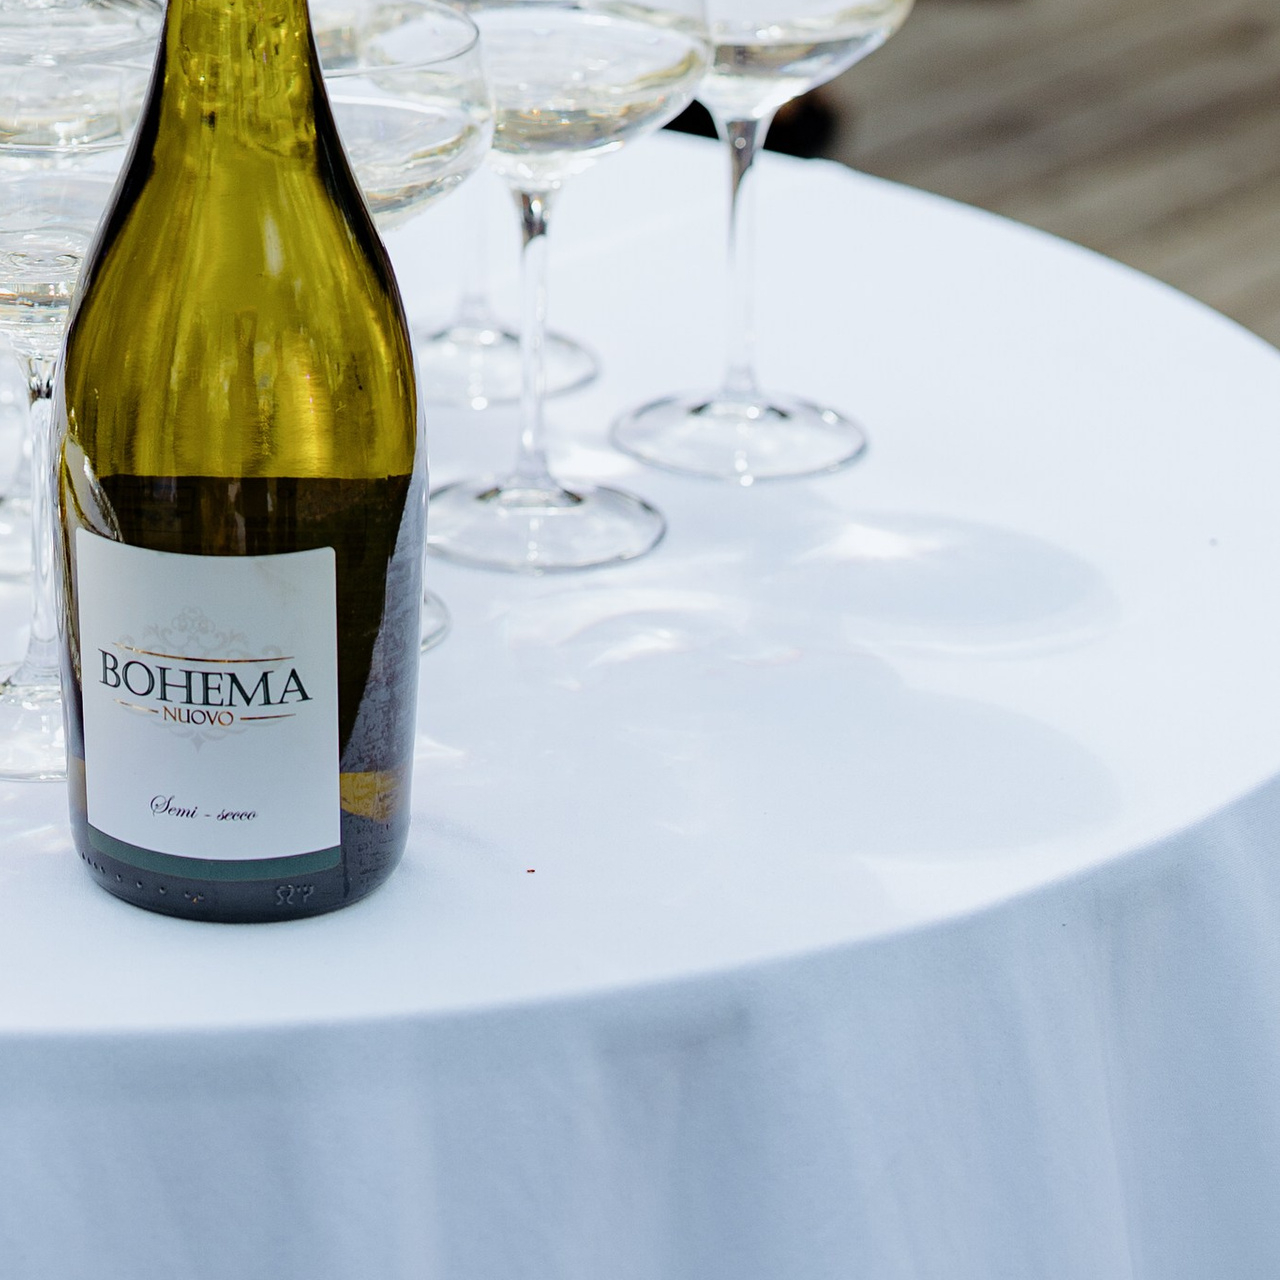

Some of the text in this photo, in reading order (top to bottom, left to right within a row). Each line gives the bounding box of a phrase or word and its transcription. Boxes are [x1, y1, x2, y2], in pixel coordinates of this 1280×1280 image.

[98, 648, 313, 708] BOHEMA
[162, 705, 235, 727] NUOVO
[149, 794, 199, 819] Semi
[216, 807, 259, 822] secco
